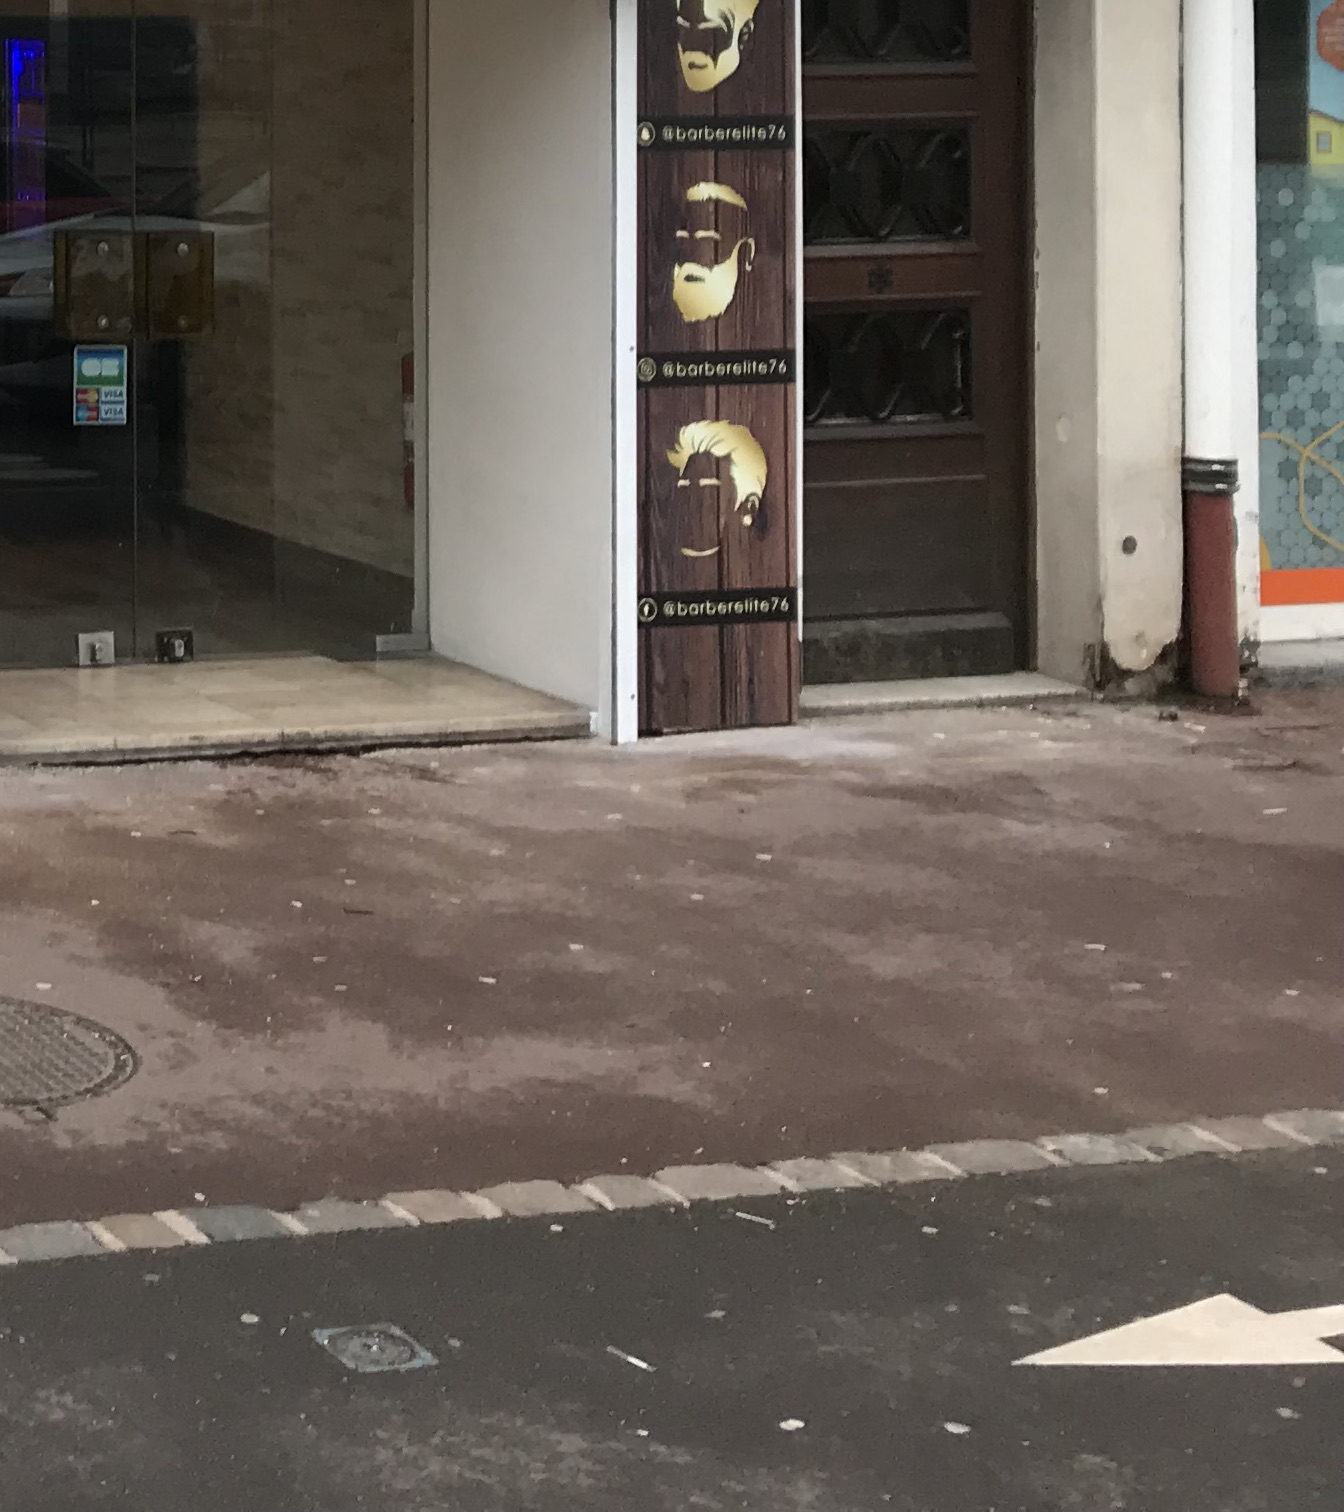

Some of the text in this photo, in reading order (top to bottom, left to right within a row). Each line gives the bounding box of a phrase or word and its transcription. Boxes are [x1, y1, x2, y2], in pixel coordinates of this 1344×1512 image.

[662, 125, 787, 142] @barberelite76
[662, 358, 787, 378] @barberelite76
[103, 390, 124, 398] VISA
[103, 408, 124, 416] VISA
[663, 597, 789, 618] @barberelite76
